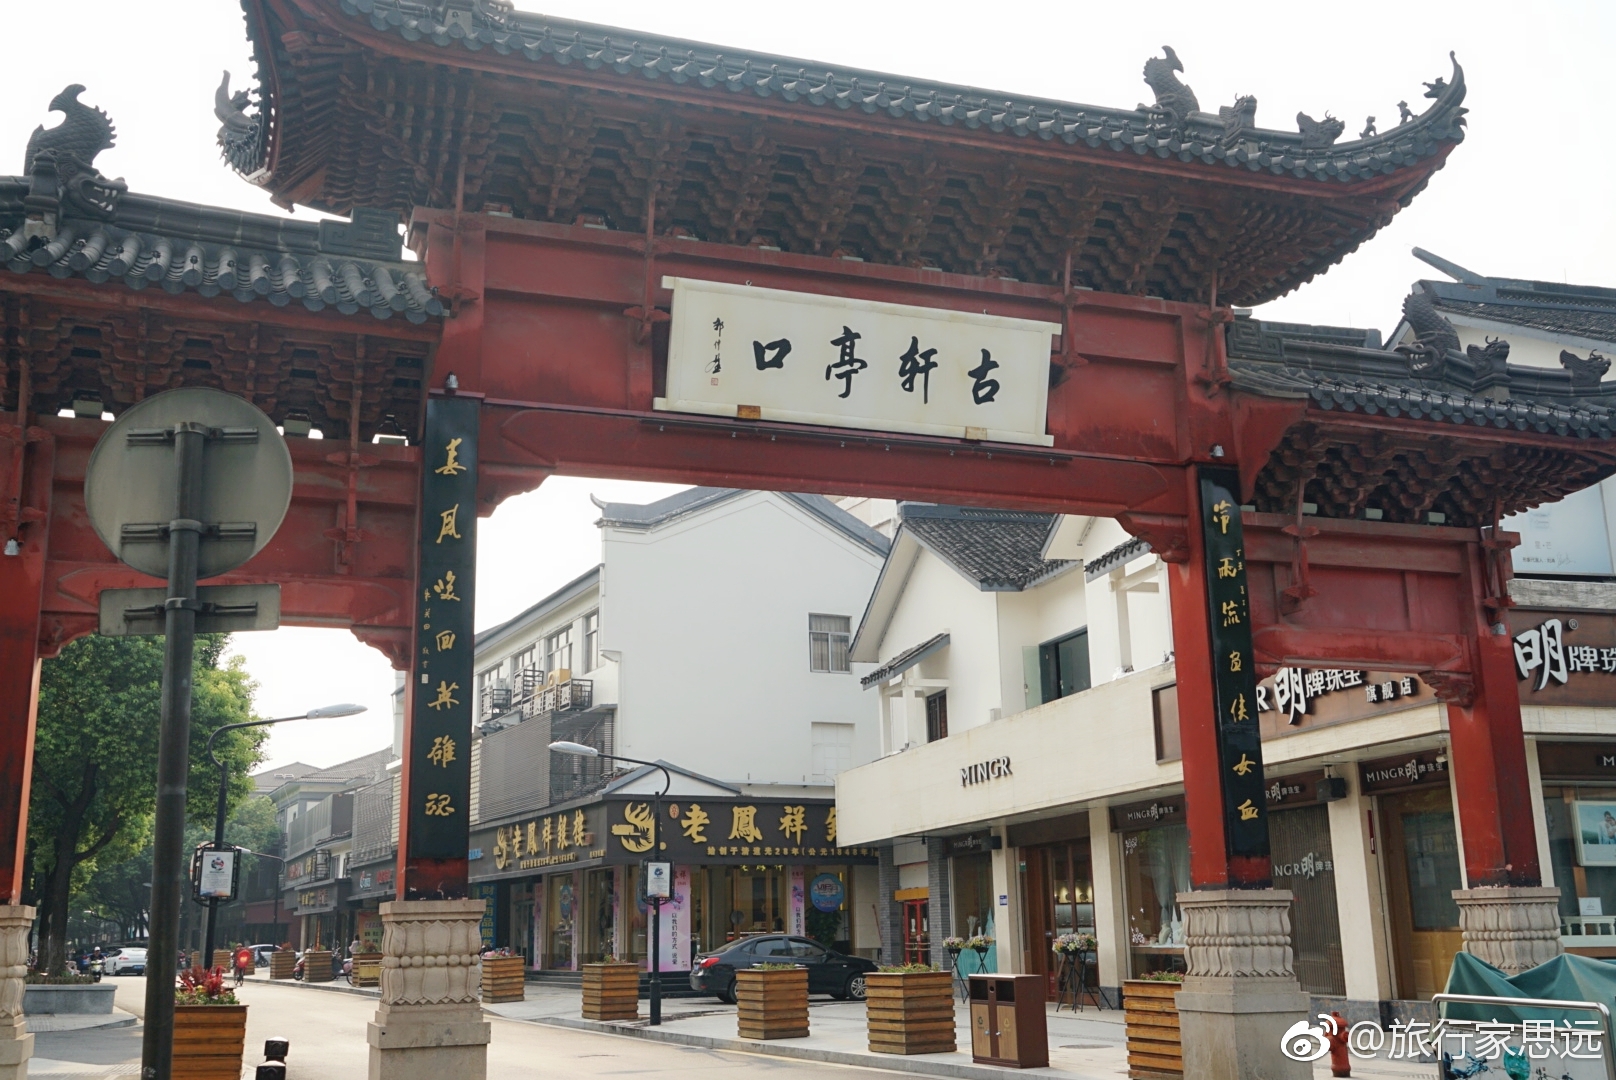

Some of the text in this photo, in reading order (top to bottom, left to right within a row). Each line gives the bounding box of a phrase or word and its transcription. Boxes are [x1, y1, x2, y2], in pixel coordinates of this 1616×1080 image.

[1365, 676, 1412, 702] 旗舰店
[960, 756, 1012, 787] MINGR
